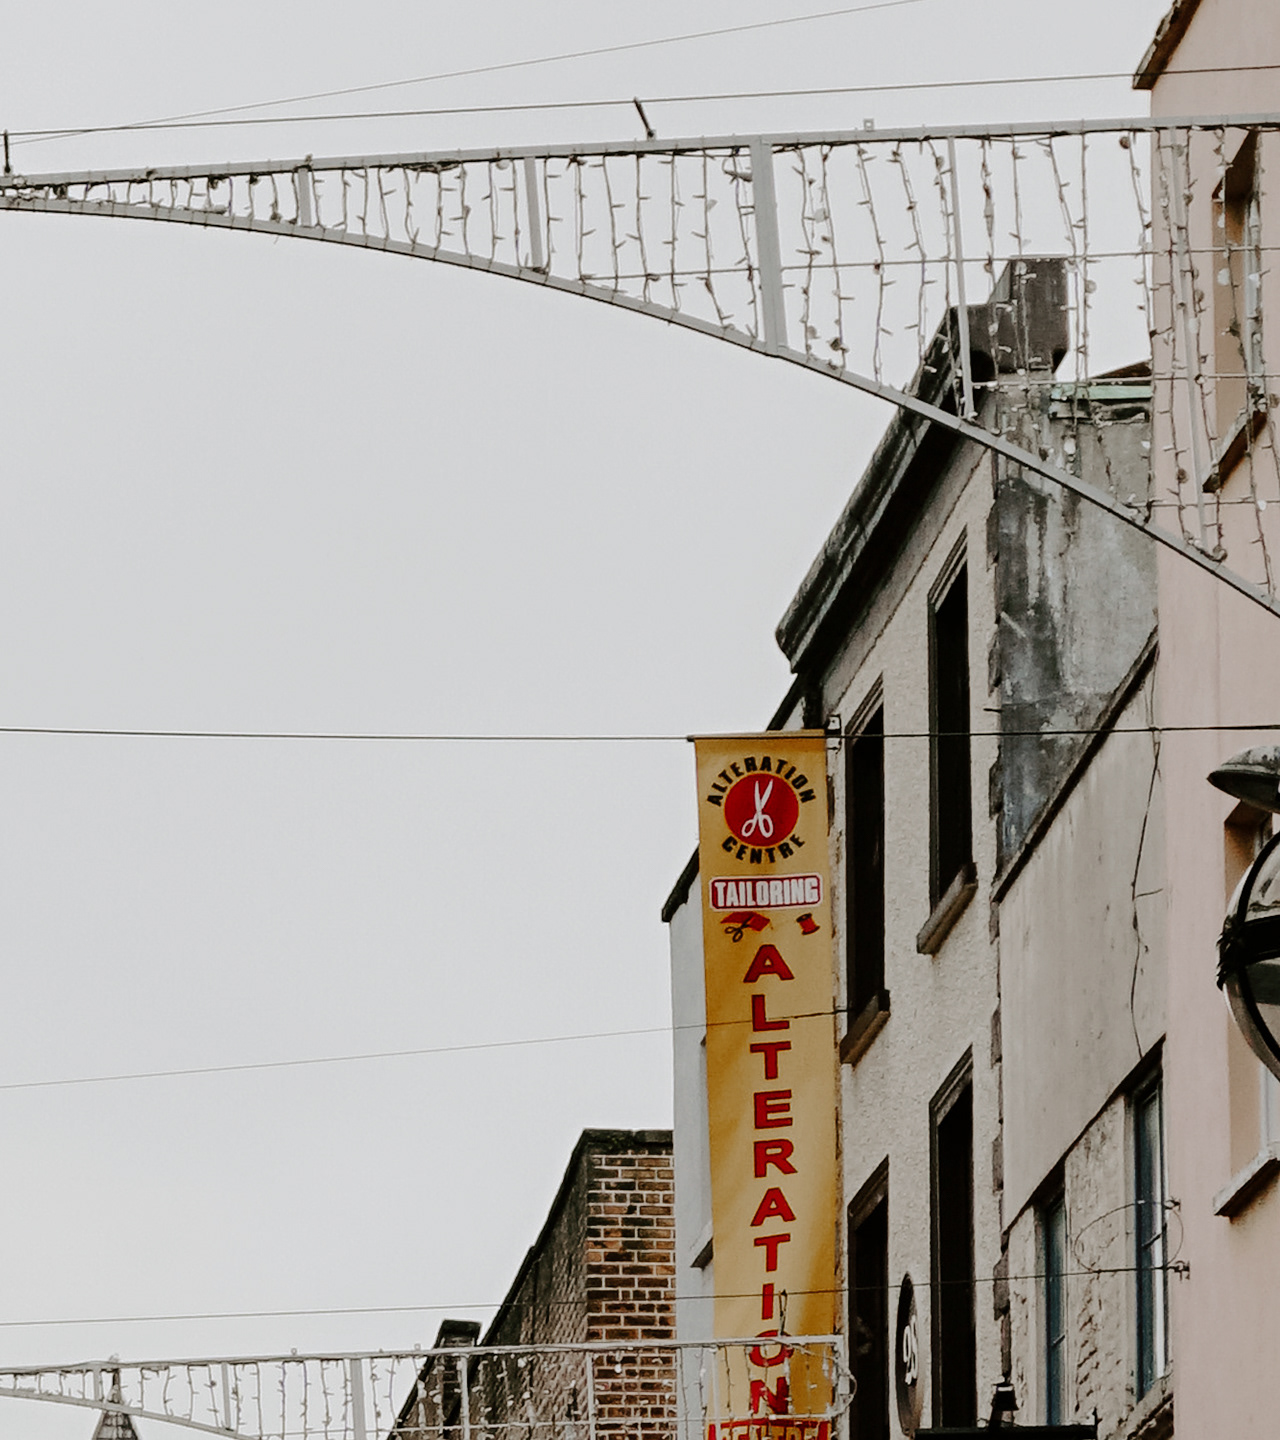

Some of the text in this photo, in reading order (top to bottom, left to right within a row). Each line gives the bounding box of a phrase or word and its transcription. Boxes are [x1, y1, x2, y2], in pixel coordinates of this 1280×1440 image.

[707, 756, 816, 807] ALTERATION
[721, 834, 806, 864] CENTRE
[714, 876, 819, 908] TAILORING
[743, 943, 798, 1416] ALTERATION
